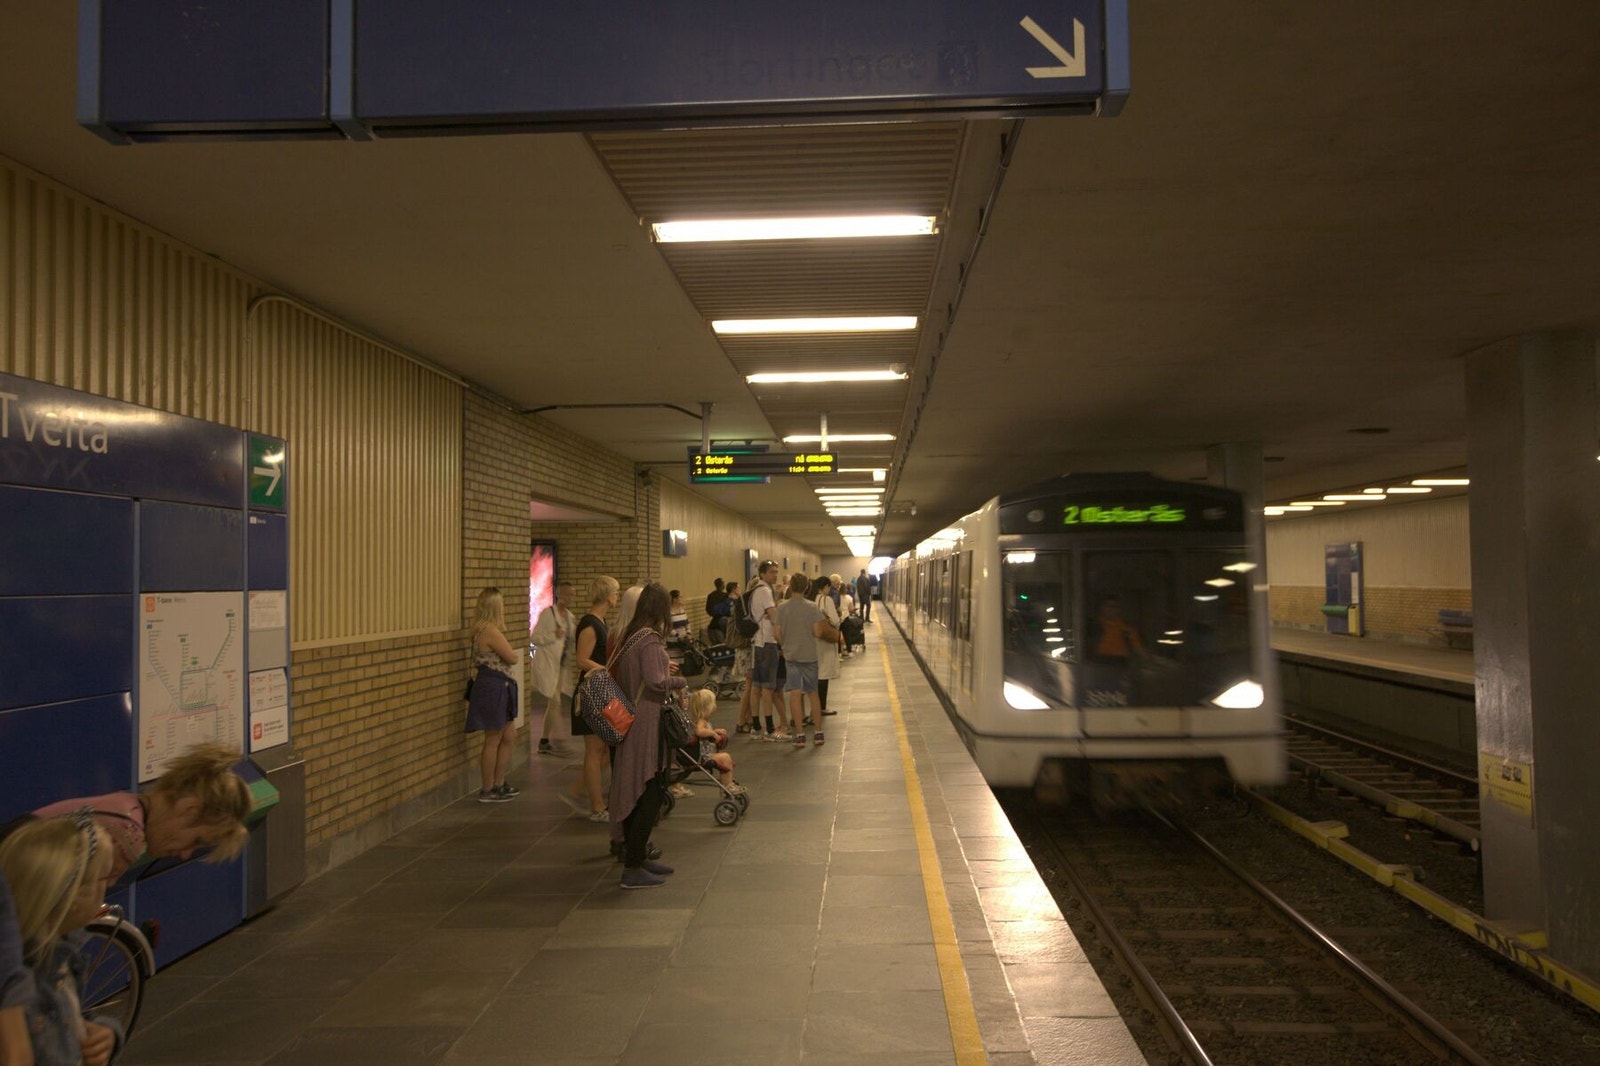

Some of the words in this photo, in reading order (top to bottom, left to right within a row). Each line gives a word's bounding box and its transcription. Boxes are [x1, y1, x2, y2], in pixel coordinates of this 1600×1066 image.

[0, 391, 108, 454] Tveita
[695, 455, 702, 465] 2
[1063, 505, 1079, 525] 2
